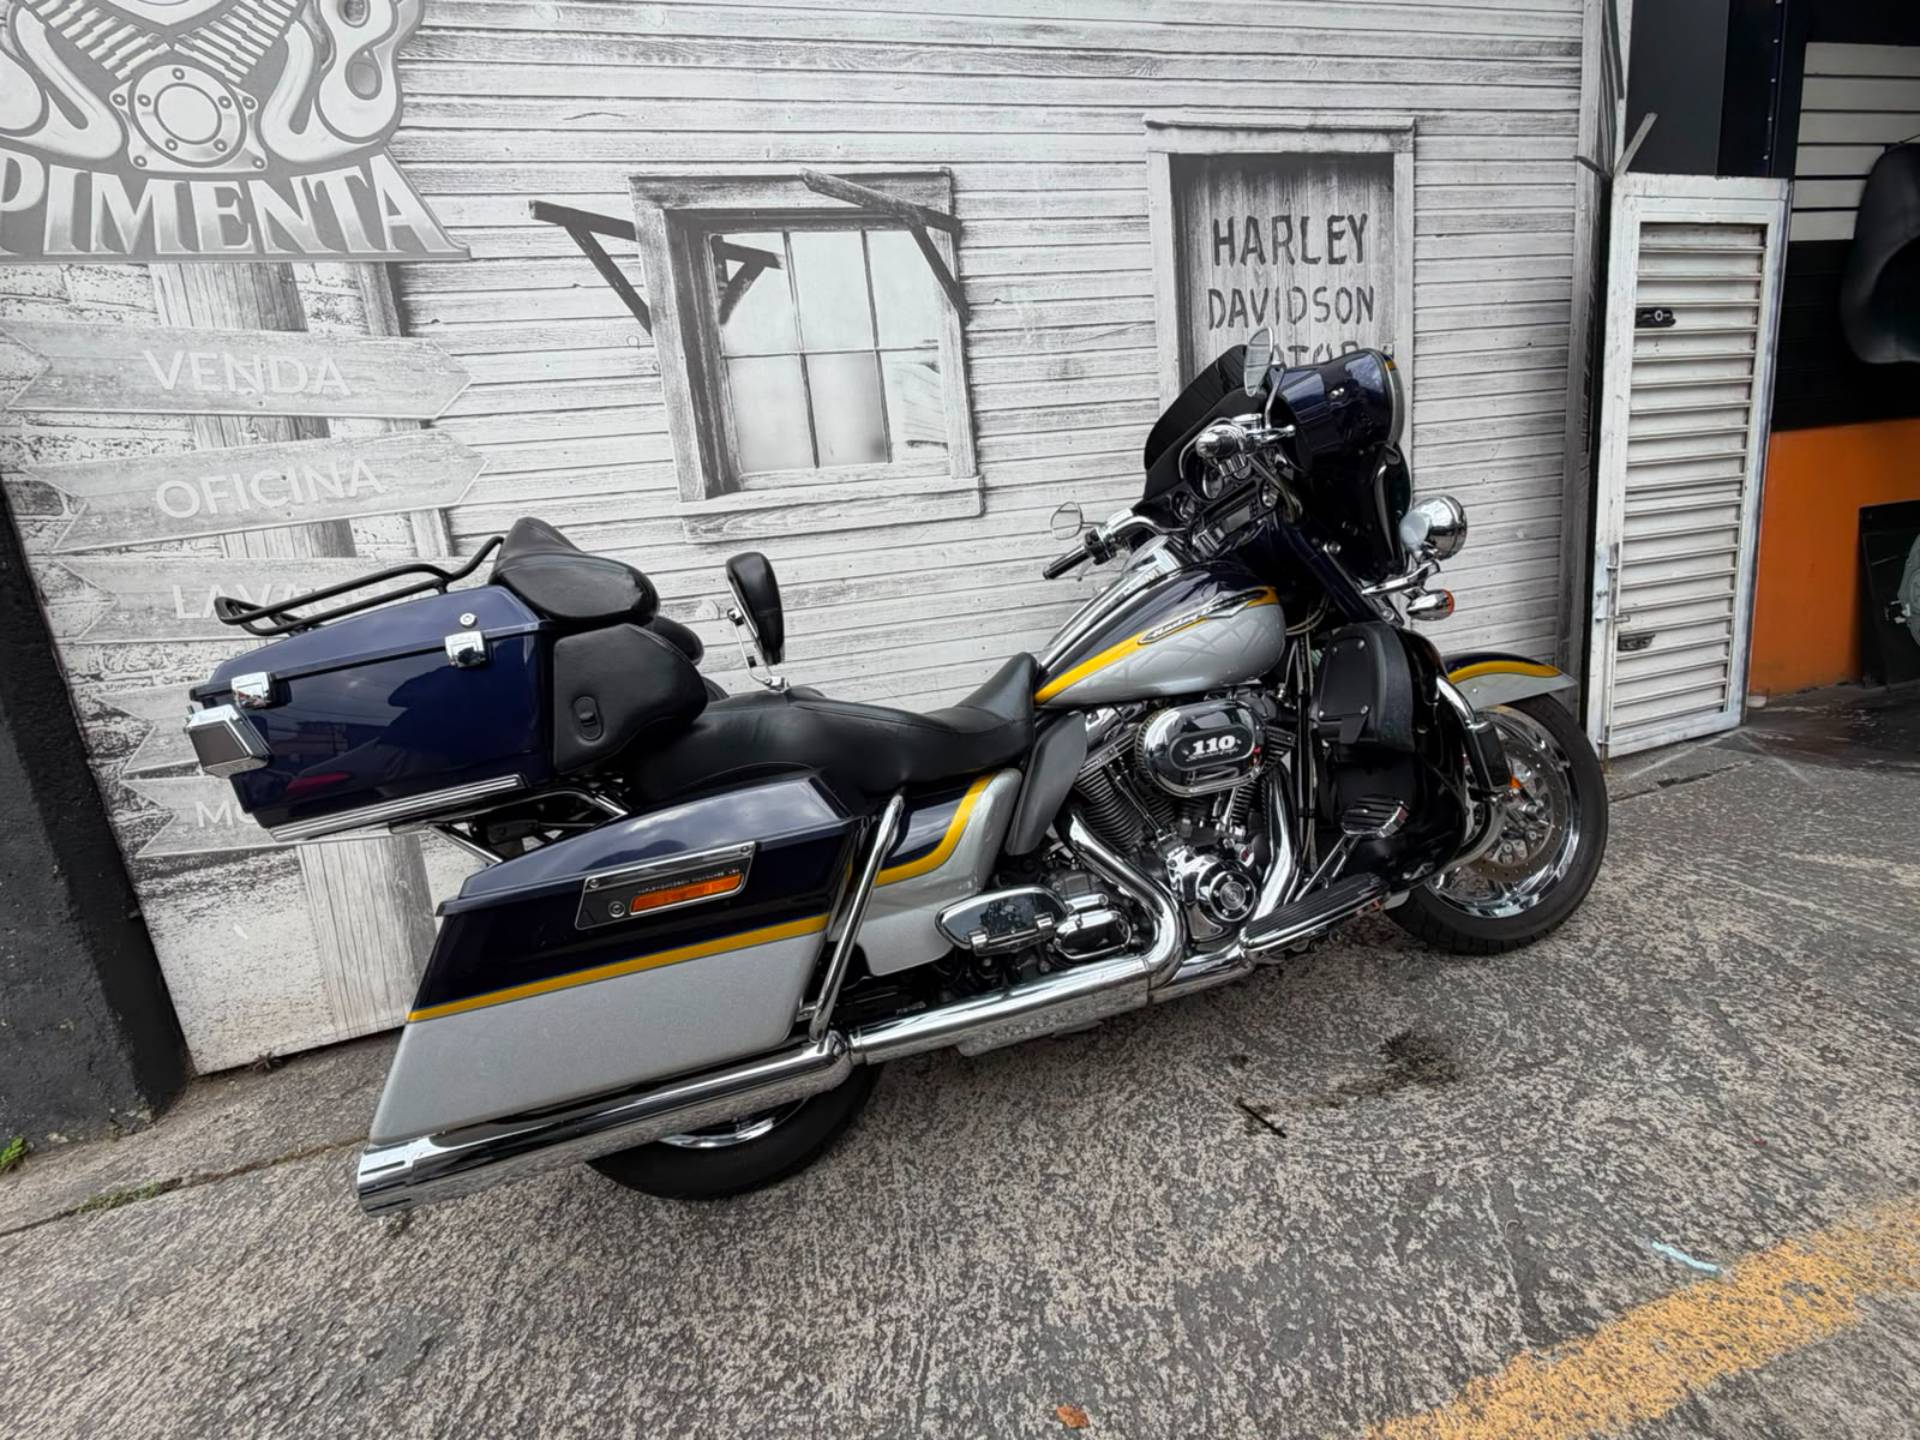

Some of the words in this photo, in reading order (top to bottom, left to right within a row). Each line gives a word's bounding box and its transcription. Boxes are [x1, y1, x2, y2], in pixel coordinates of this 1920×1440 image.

[0, 147, 464, 255] PIMENTA
[1213, 213, 1368, 267] HARLEY
[1208, 286, 1374, 330] DAVIDSON
[142, 349, 352, 397] VENDA
[155, 458, 388, 519] OFICINA
[1192, 735, 1236, 756] 110
